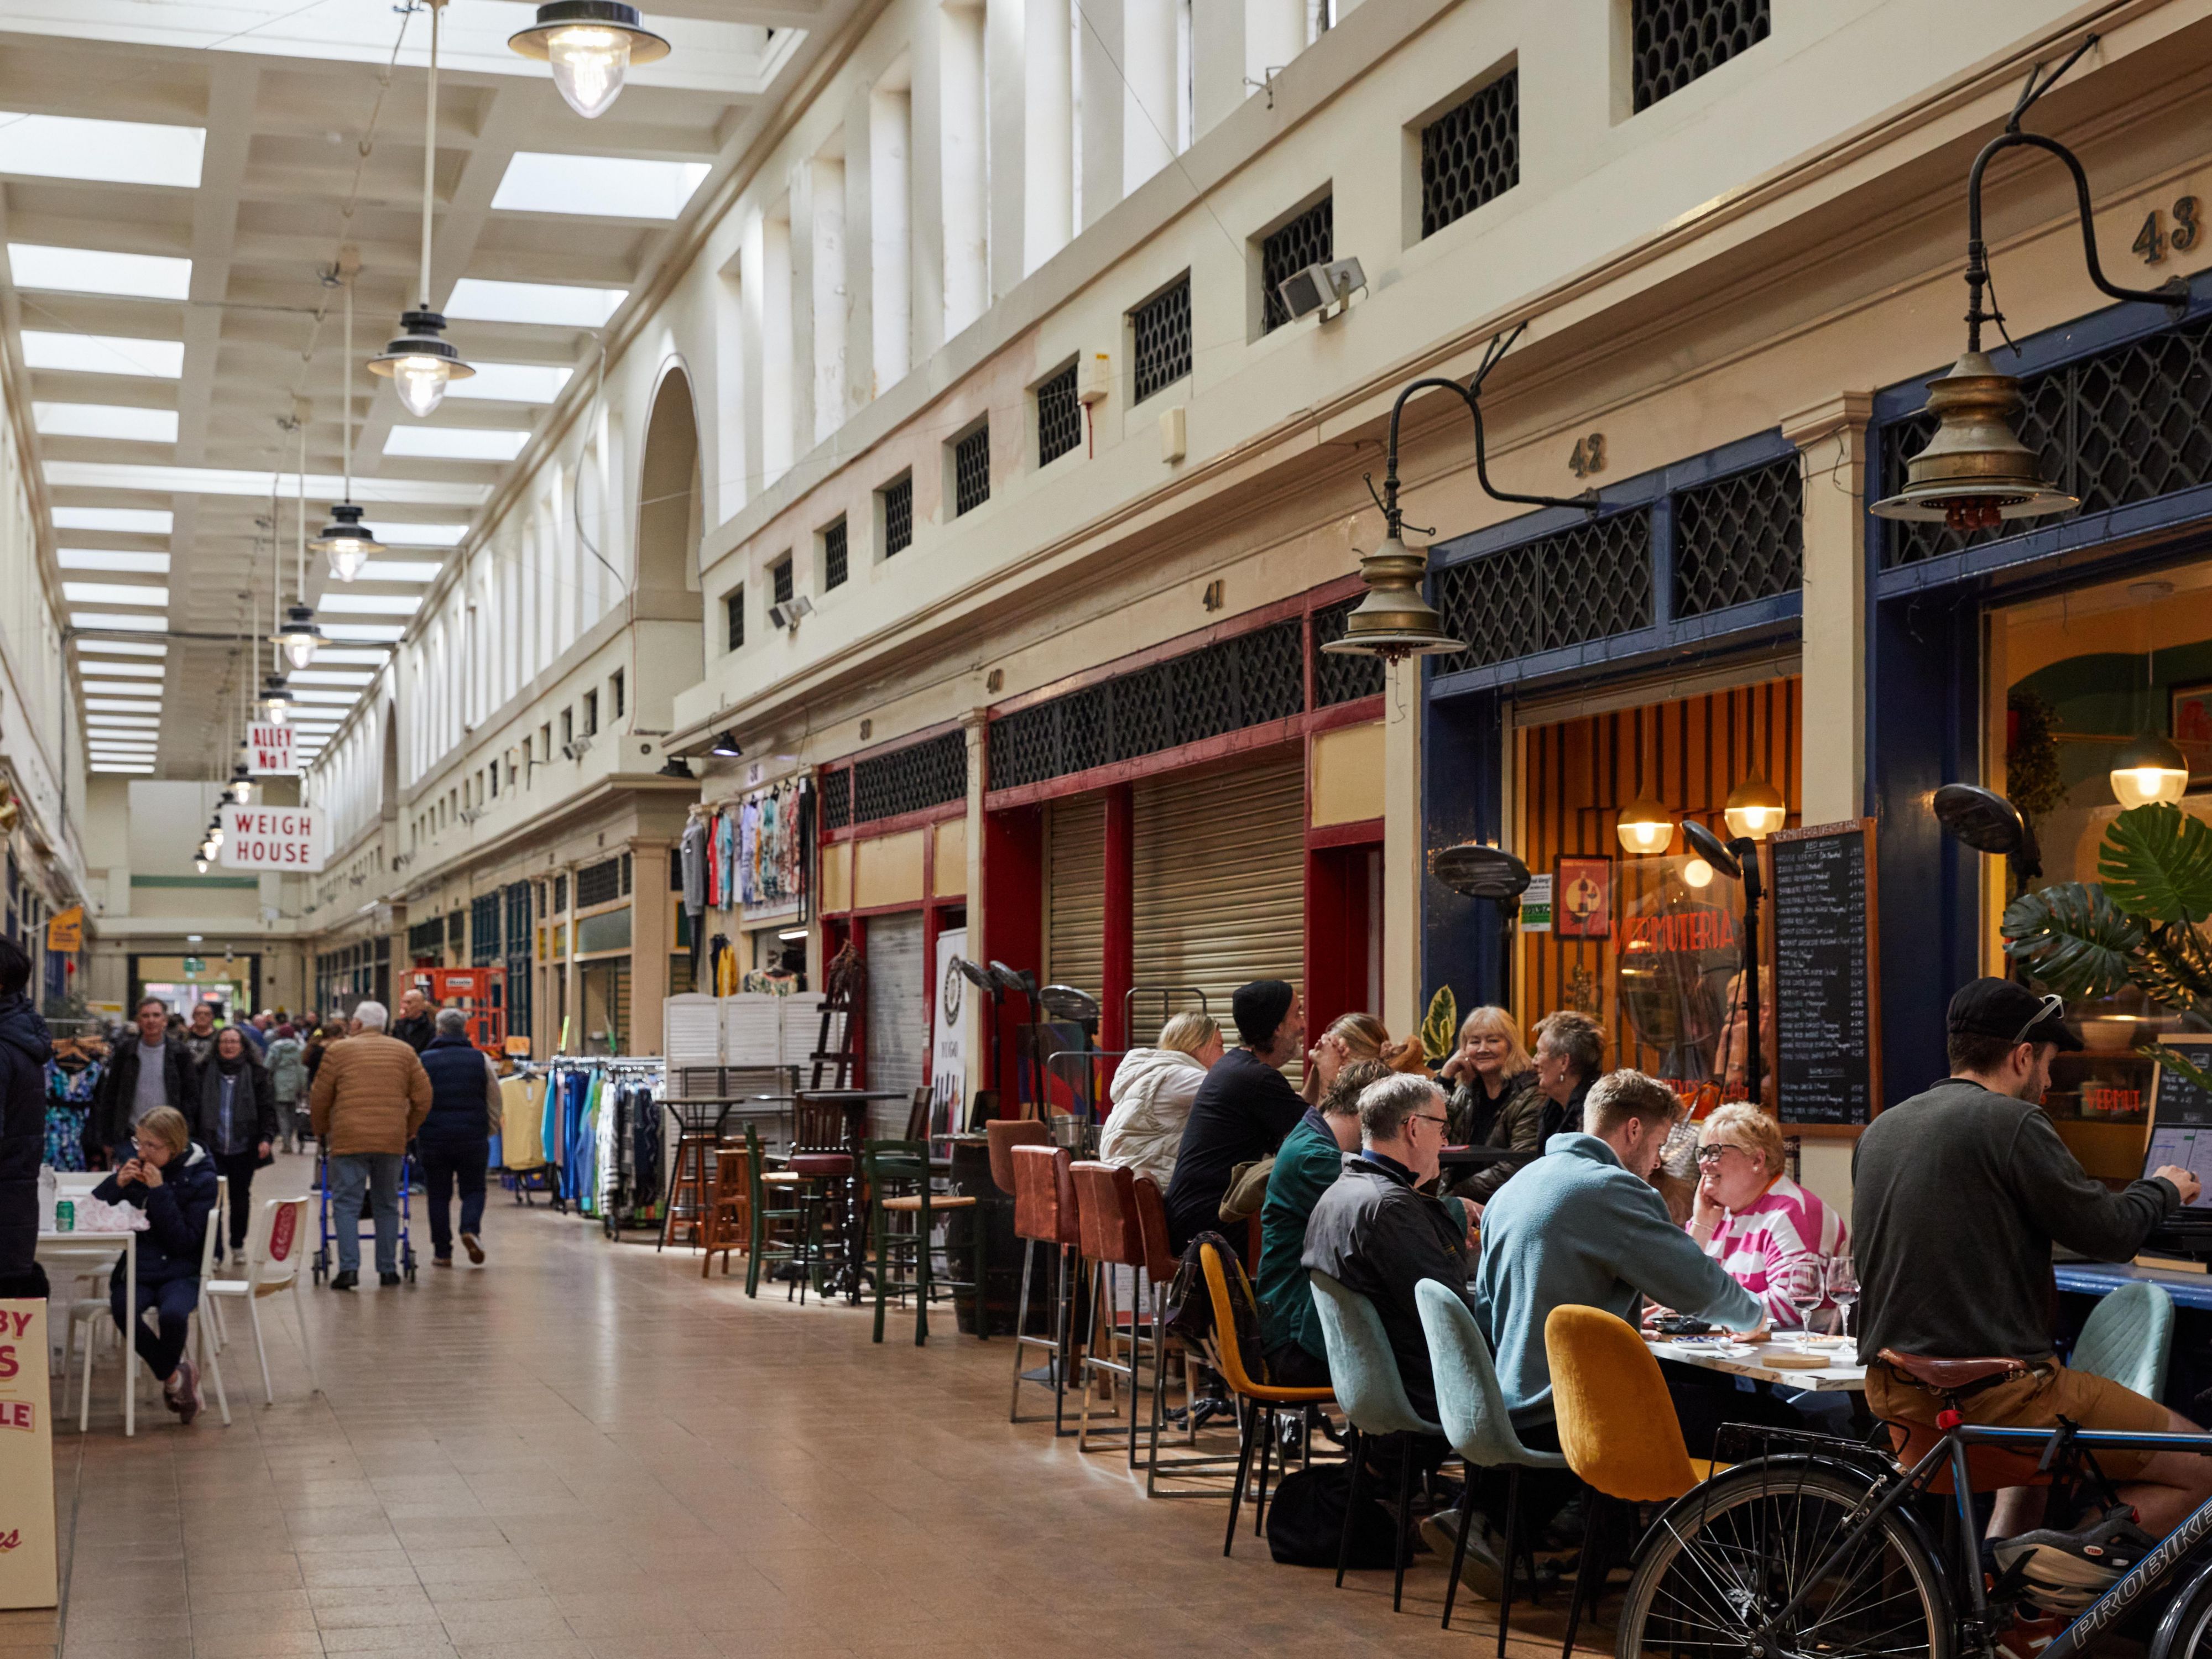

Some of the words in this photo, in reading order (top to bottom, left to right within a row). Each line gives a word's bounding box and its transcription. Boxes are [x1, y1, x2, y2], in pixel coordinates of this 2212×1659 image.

[2132, 195, 2201, 264] 43
[1568, 432, 1606, 478] 42
[1203, 580, 1223, 612] 41
[253, 728, 293, 748] ALLEY
[259, 750, 277, 769] No
[281, 750, 289, 769] 1
[235, 813, 311, 836] WEIGH
[237, 841, 309, 864] HOUSE
[1609, 909, 1735, 954] VERMUTERIA
[2084, 1088, 2141, 1112] VERMUT
